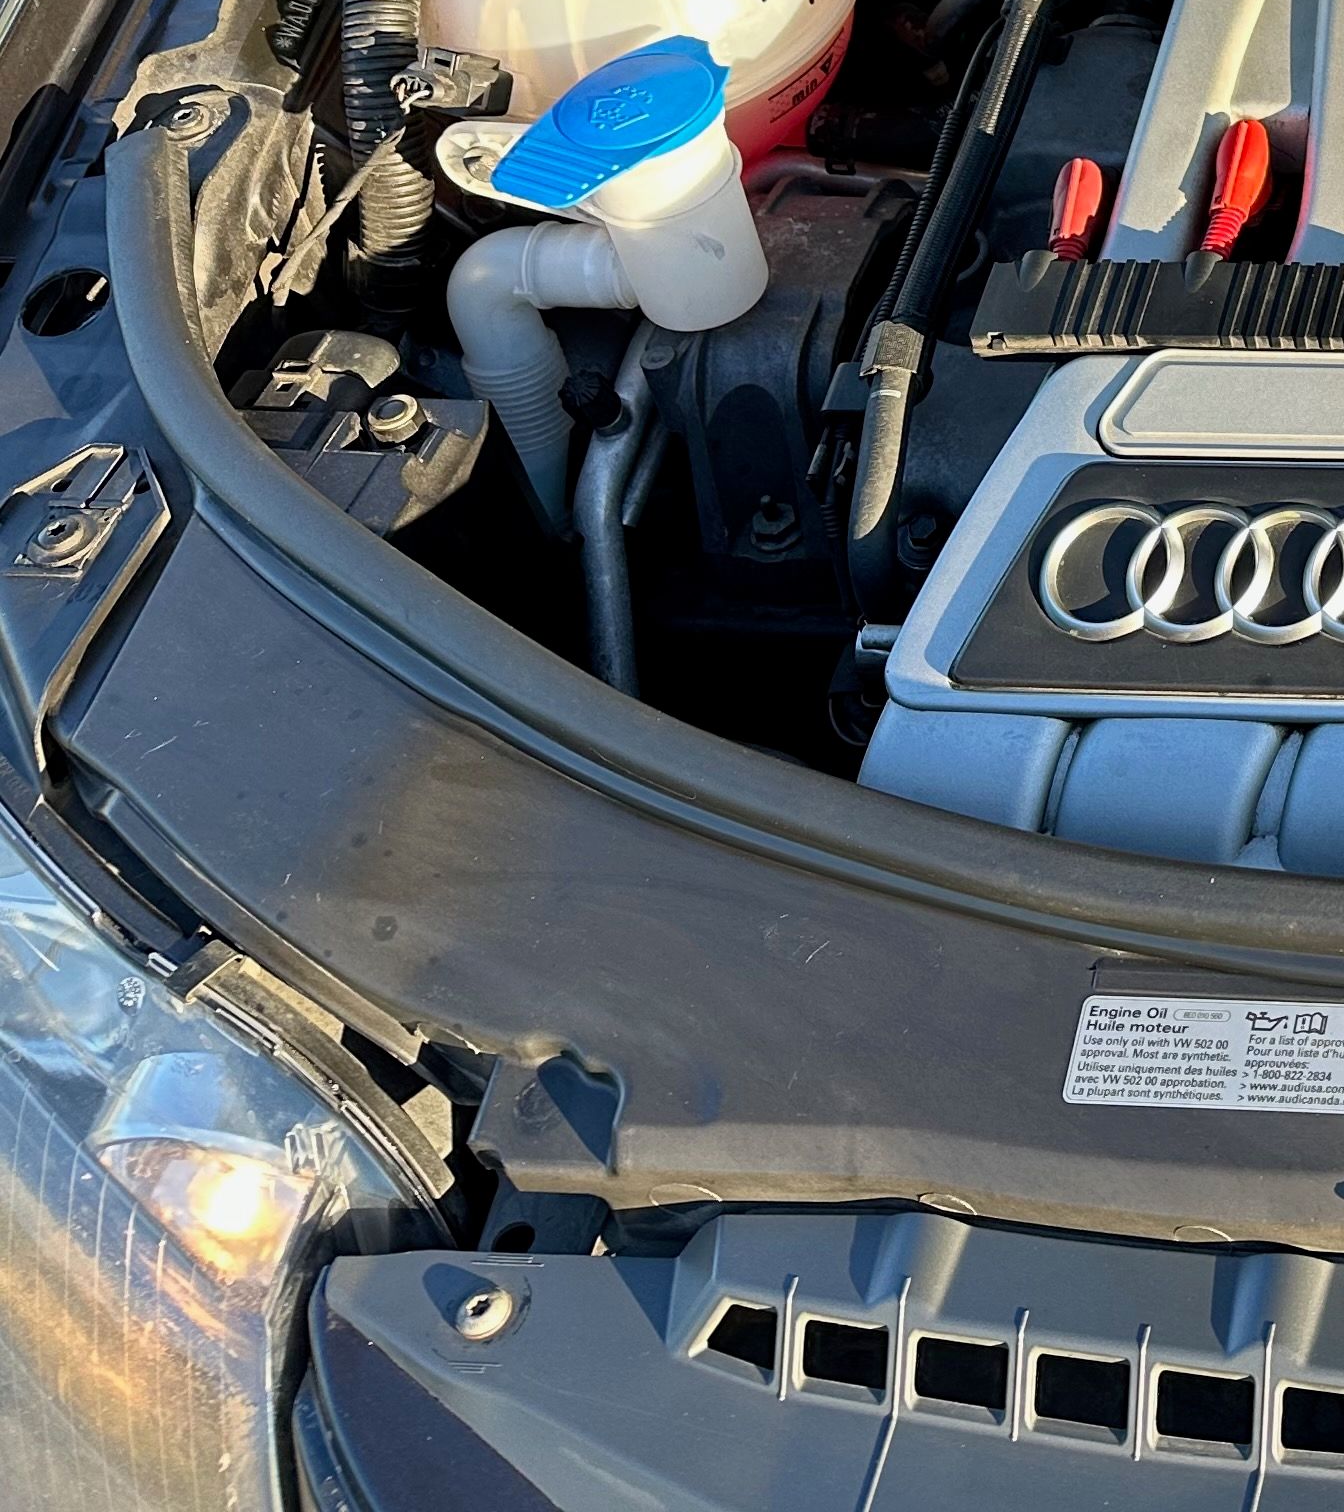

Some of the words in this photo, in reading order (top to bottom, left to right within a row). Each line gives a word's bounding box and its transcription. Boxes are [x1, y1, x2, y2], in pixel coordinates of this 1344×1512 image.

[792, 78, 818, 105] min
[1089, 1006, 1142, 1019] Engine
[1147, 1007, 1168, 1019] Oil
[1086, 1020, 1125, 1032] Huile
[1130, 1023, 1189, 1034] moteur
[1083, 1035, 1102, 1045] Use
[1105, 1037, 1129, 1048] only
[1131, 1037, 1145, 1047] oil
[1149, 1038, 1170, 1048] with
[1173, 1038, 1192, 1048] VW
[1194, 1039, 1213, 1049] 502
[1215, 1040, 1229, 1049] 00
[1249, 1035, 1267, 1044] For
[1278, 1036, 1295, 1046] list
[1297, 1036, 1308, 1046] of
[1080, 1048, 1129, 1059] approval.
[1132, 1050, 1159, 1059] Most
[1161, 1051, 1179, 1060] are
[1181, 1051, 1232, 1062] synthetic.
[1246, 1046, 1273, 1057] Pour
[1274, 1048, 1295, 1058] une
[1297, 1048, 1319, 1058] liste
[1077, 1061, 1116, 1072] Utilisez
[1118, 1064, 1182, 1075] uniquement
[1184, 1065, 1203, 1075] des
[1205, 1066, 1237, 1077] huiles
[1252, 1070, 1332, 1081] 1-800-822-2834
[1074, 1075, 1100, 1084] avec
[1102, 1075, 1121, 1084] VW
[1123, 1075, 1142, 1085] 502
[1144, 1076, 1158, 1086] 00
[1160, 1078, 1227, 1089] approbation.
[1071, 1085, 1085, 1095] La
[1087, 1086, 1125, 1098] plupart
[1127, 1088, 1150, 1097] sont
